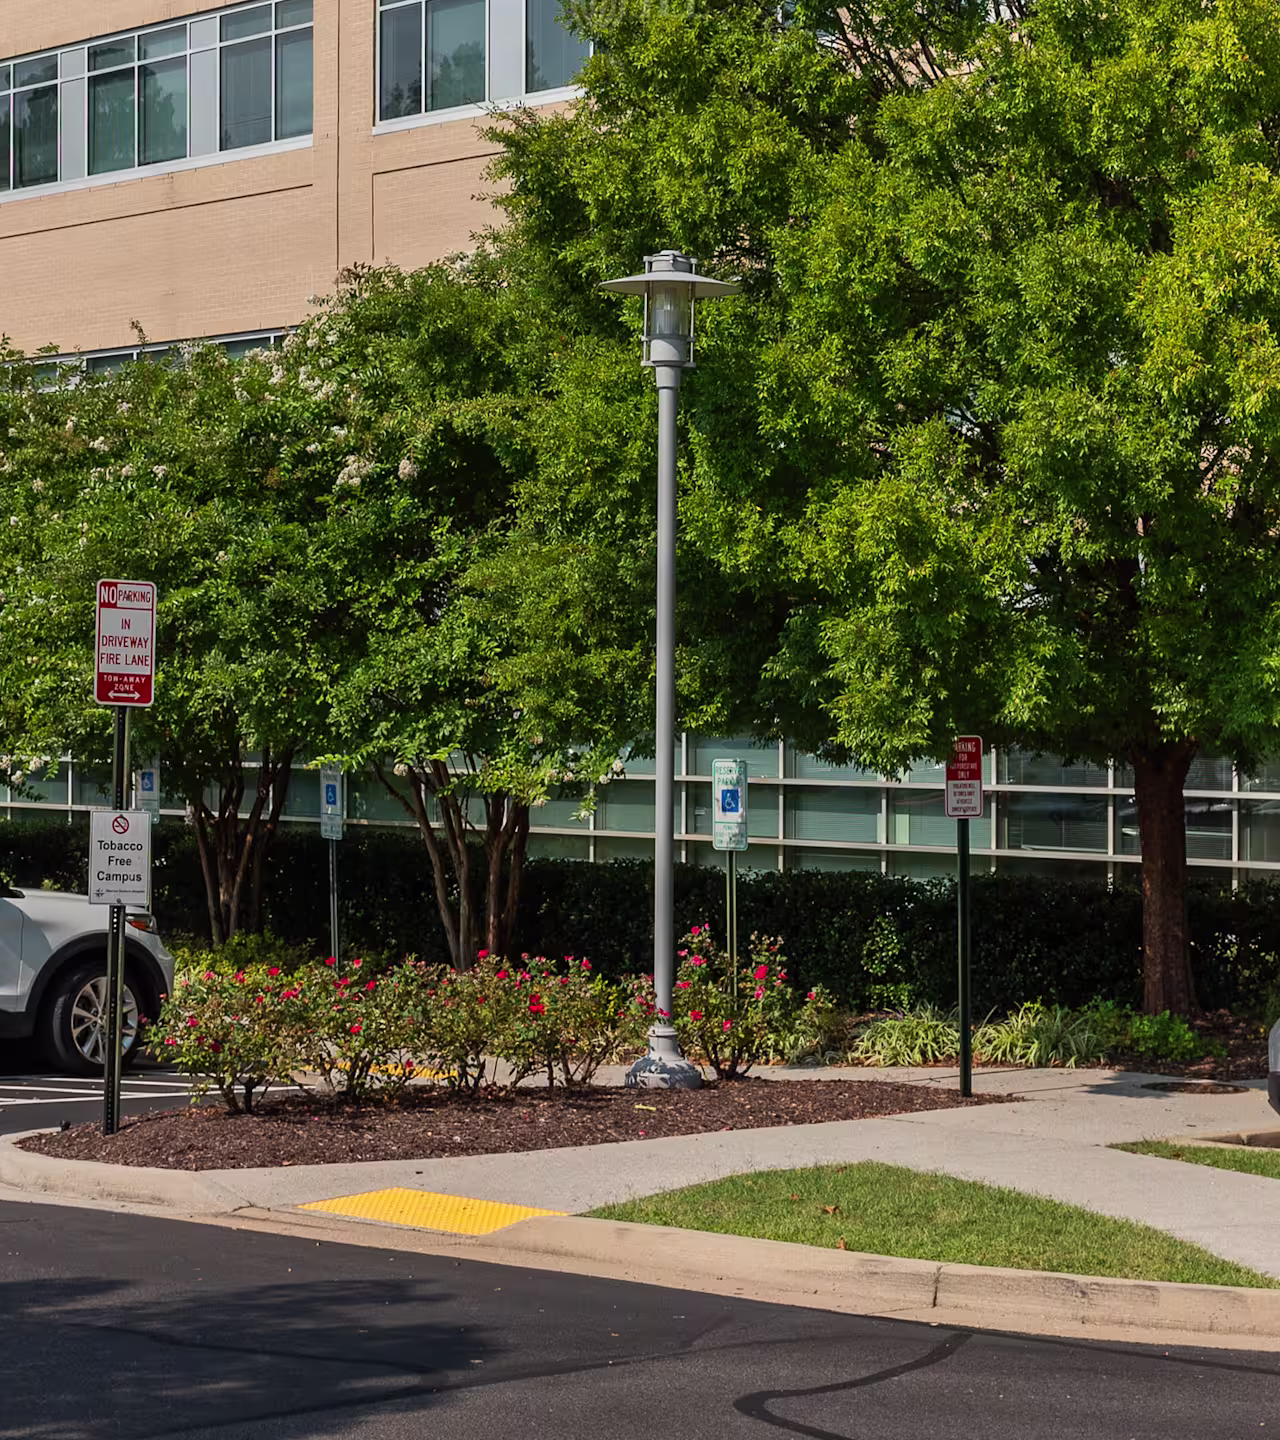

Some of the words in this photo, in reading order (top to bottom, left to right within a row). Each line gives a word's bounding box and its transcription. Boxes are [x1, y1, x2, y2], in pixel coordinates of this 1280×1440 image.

[100, 585, 117, 604] NO
[118, 589, 151, 604] PARKING
[121, 617, 131, 630] IN
[101, 635, 149, 649] DRIVEWAY
[100, 653, 121, 665] FIRE
[125, 654, 150, 667] LANE
[103, 675, 146, 684] TOW-AWAY
[114, 683, 135, 692] ZONE
[954, 742, 976, 753] ARKING
[97, 840, 143, 851] Tobacco
[108, 855, 132, 866] Free
[97, 870, 143, 884] Campus
